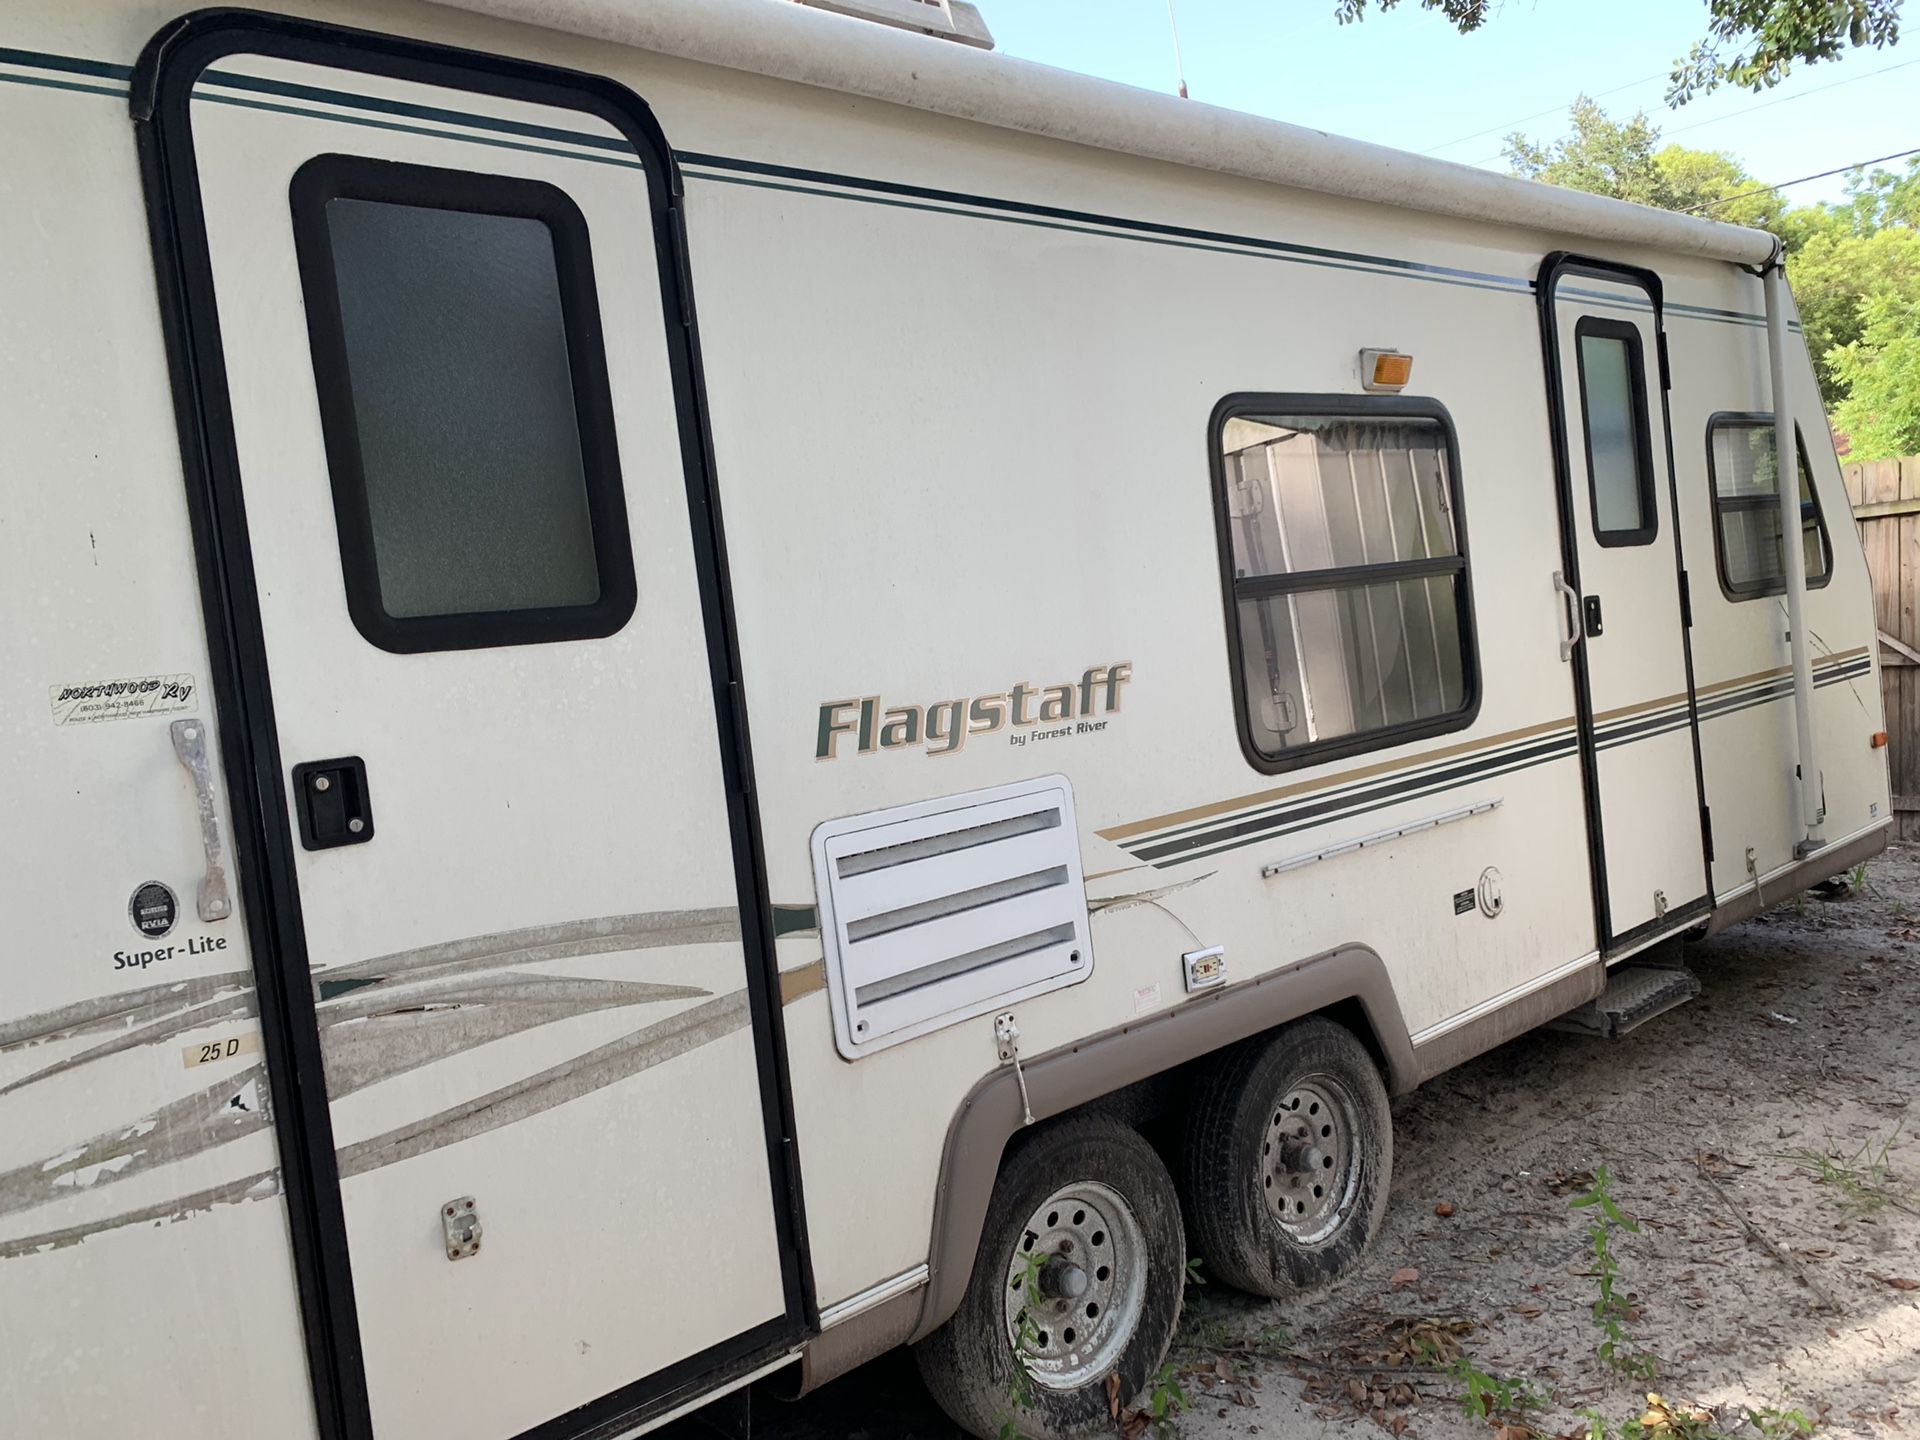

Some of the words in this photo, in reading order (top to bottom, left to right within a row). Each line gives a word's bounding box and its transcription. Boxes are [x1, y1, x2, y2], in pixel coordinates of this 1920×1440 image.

[58, 680, 161, 701] NORTHWOOD
[162, 682, 192, 702] RV
[815, 659, 1133, 763] Flagstaff
[1010, 733, 1026, 747] by
[1031, 726, 1072, 742] Forest
[1076, 719, 1108, 734] River
[141, 918, 170, 930] RVIA
[199, 1042, 222, 1064] 25
[226, 1038, 240, 1057] D
